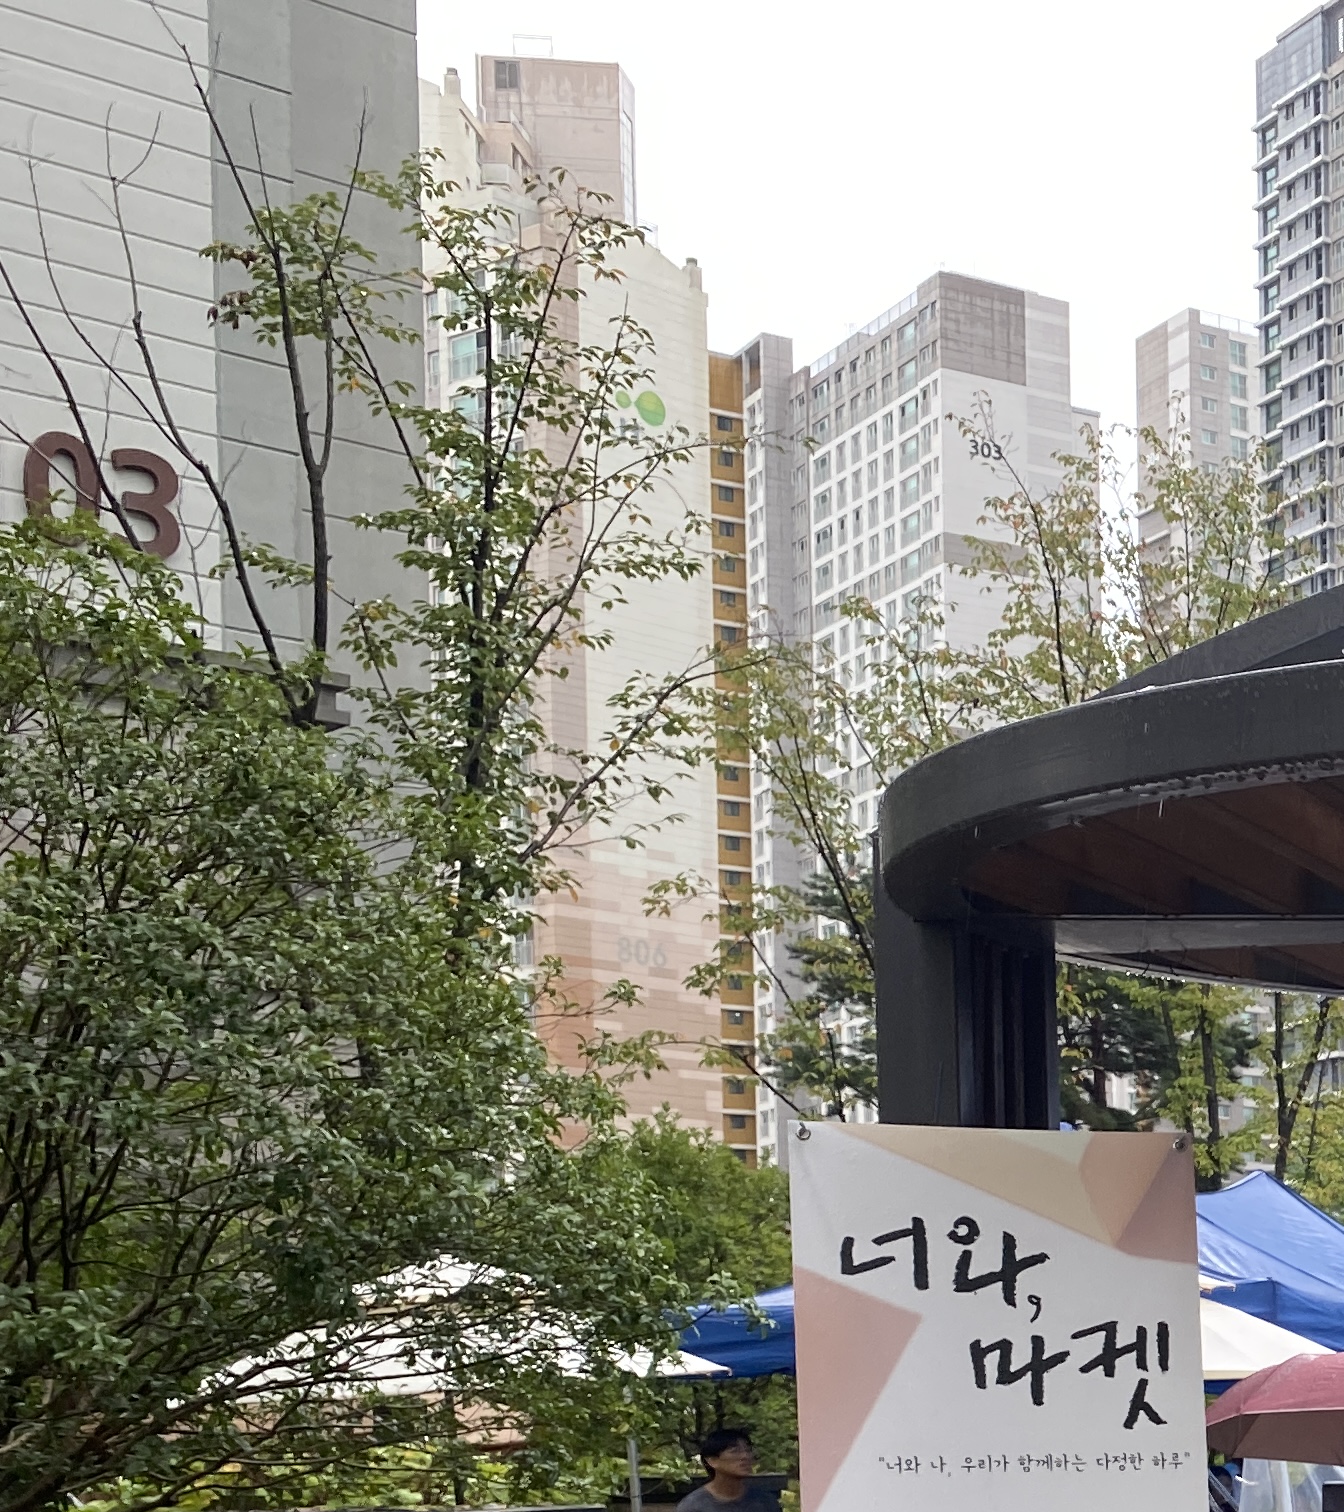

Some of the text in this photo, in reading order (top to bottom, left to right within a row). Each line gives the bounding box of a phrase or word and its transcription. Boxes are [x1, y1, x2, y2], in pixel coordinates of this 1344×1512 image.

[969, 439, 1003, 460] 303
[618, 937, 667, 968] 806
[840, 1216, 1050, 1322] 너와,
[969, 1320, 1169, 1429] 마켓
[930, 1456, 952, 1477] 나,
[961, 1454, 1008, 1473] 우리가
[1018, 1454, 1087, 1473] 함께하는
[1097, 1453, 1144, 1472] 다정한
